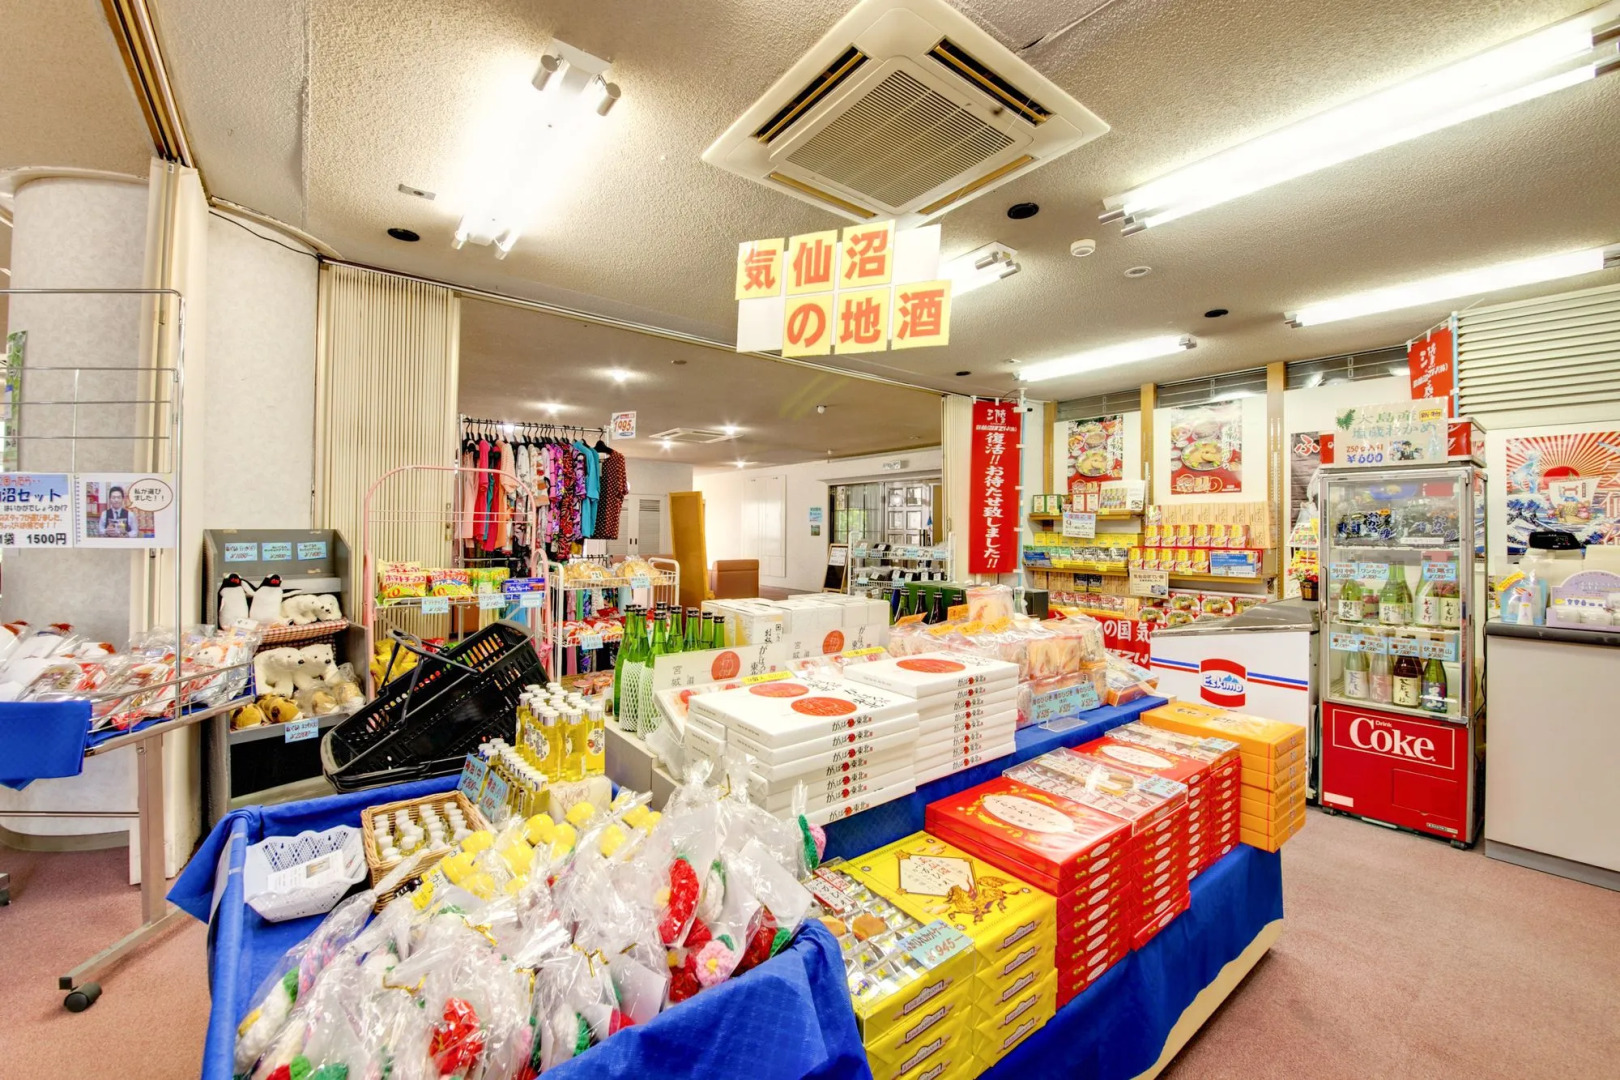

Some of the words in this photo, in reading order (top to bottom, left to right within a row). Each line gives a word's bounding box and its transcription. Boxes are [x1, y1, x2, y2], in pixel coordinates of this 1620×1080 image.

[744, 229, 888, 292] 気仙沼
[786, 288, 945, 348] の地酒
[1347, 452, 1383, 463] ¥600
[0, 487, 62, 503] 沼セット
[26, 533, 67, 545] 1500円
[1203, 674, 1244, 693] Eskimo
[1375, 720, 1392, 728] Drink
[1349, 717, 1435, 762] Coke
